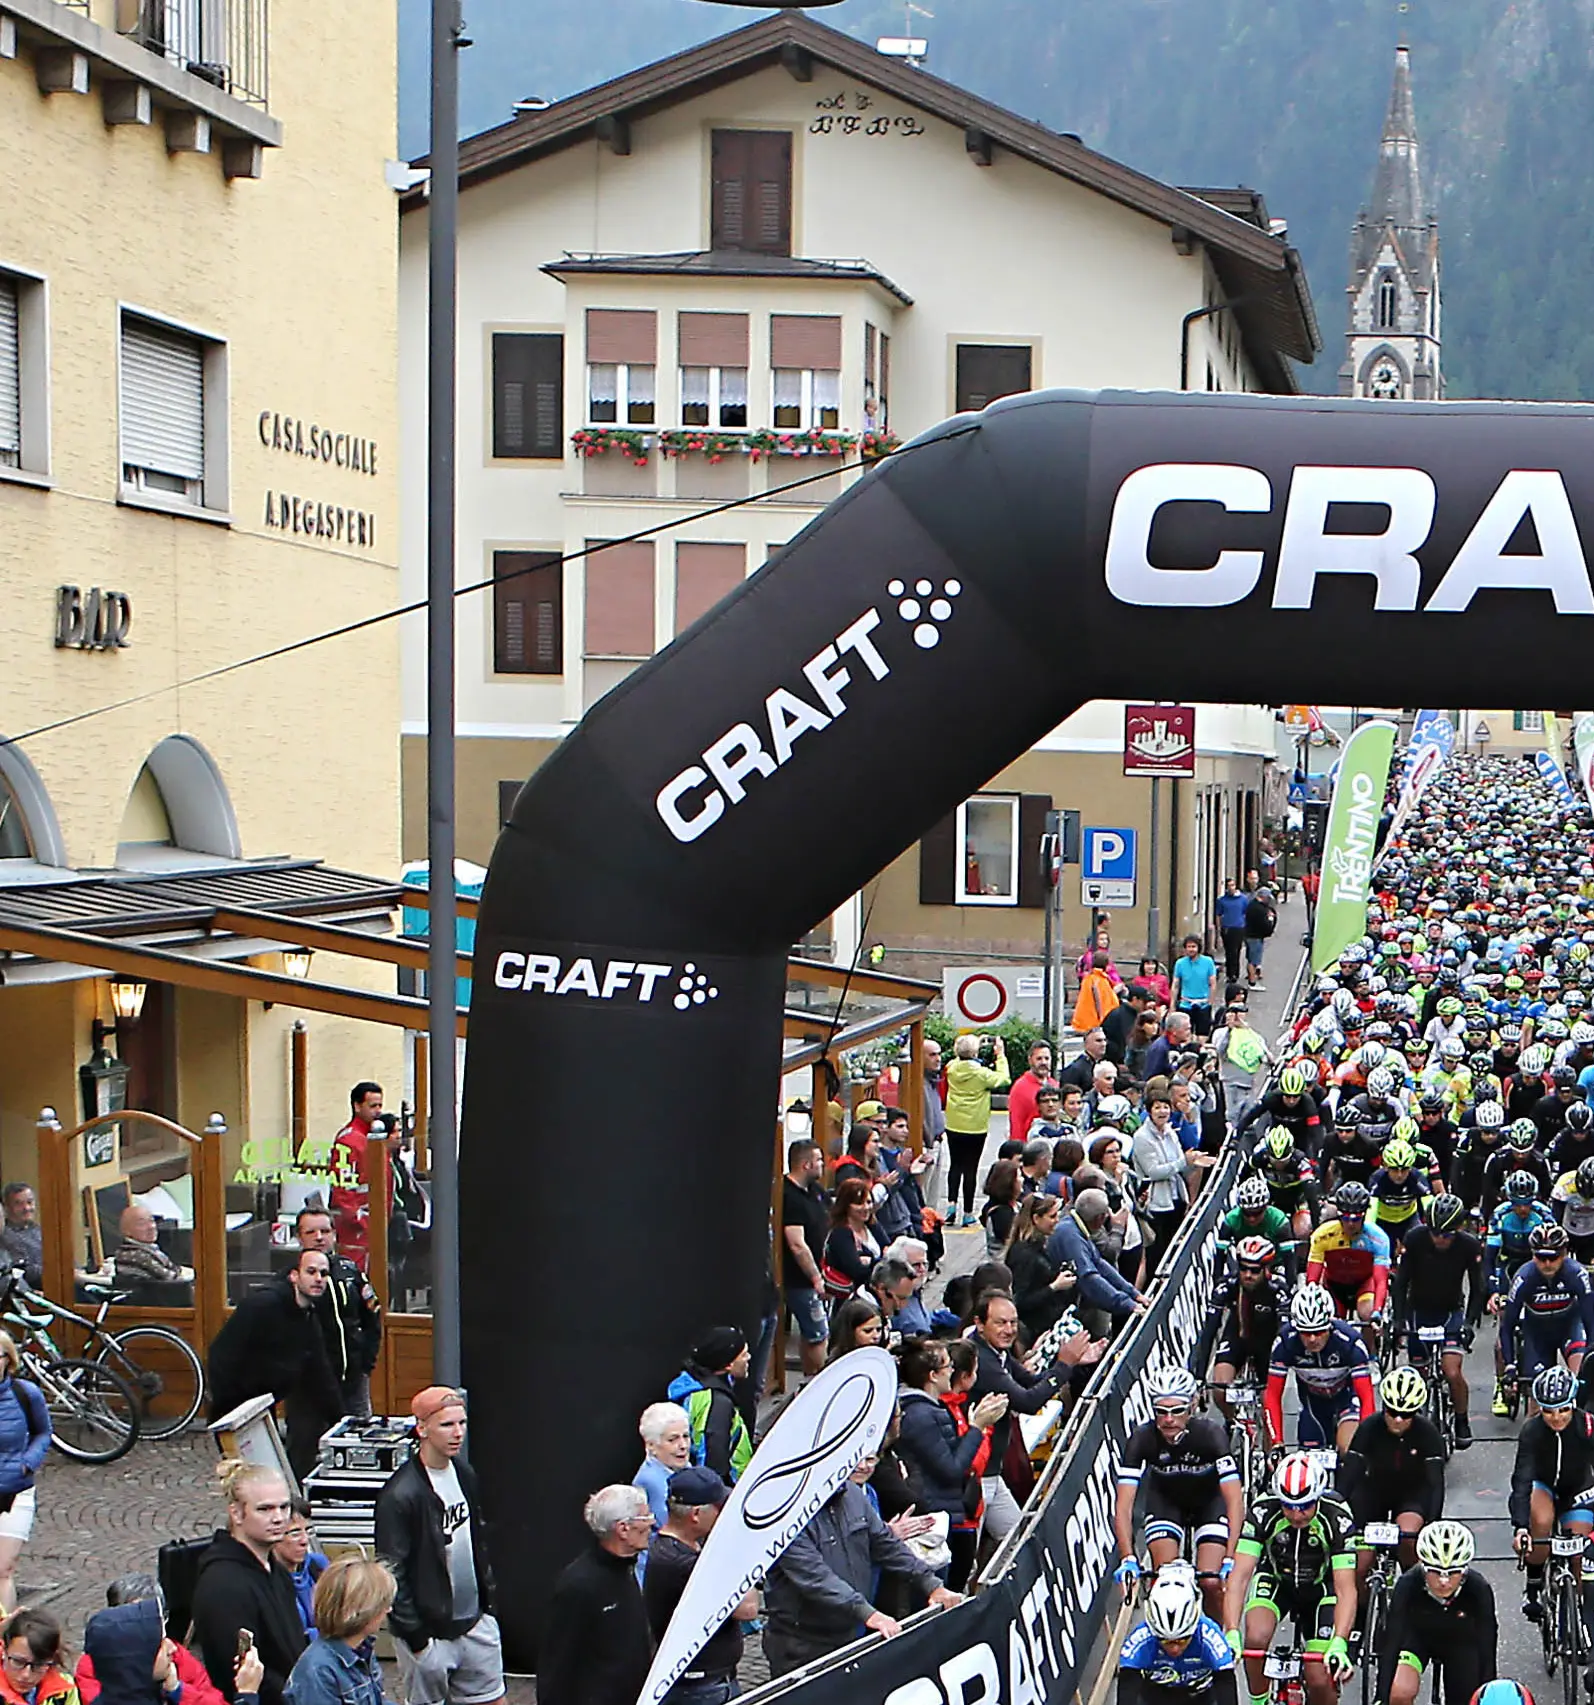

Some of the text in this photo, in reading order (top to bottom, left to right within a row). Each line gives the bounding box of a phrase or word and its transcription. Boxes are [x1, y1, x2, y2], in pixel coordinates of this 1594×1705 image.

[54, 584, 132, 653] BAR
[655, 606, 891, 843] CRAFT
[1091, 832, 1126, 874] P
[1332, 772, 1377, 904] TRENTINO
[493, 950, 673, 1002] CRAFT
[241, 1137, 352, 1169] GELATI
[652, 1442, 866, 1702] Gran Fondo World Tour
